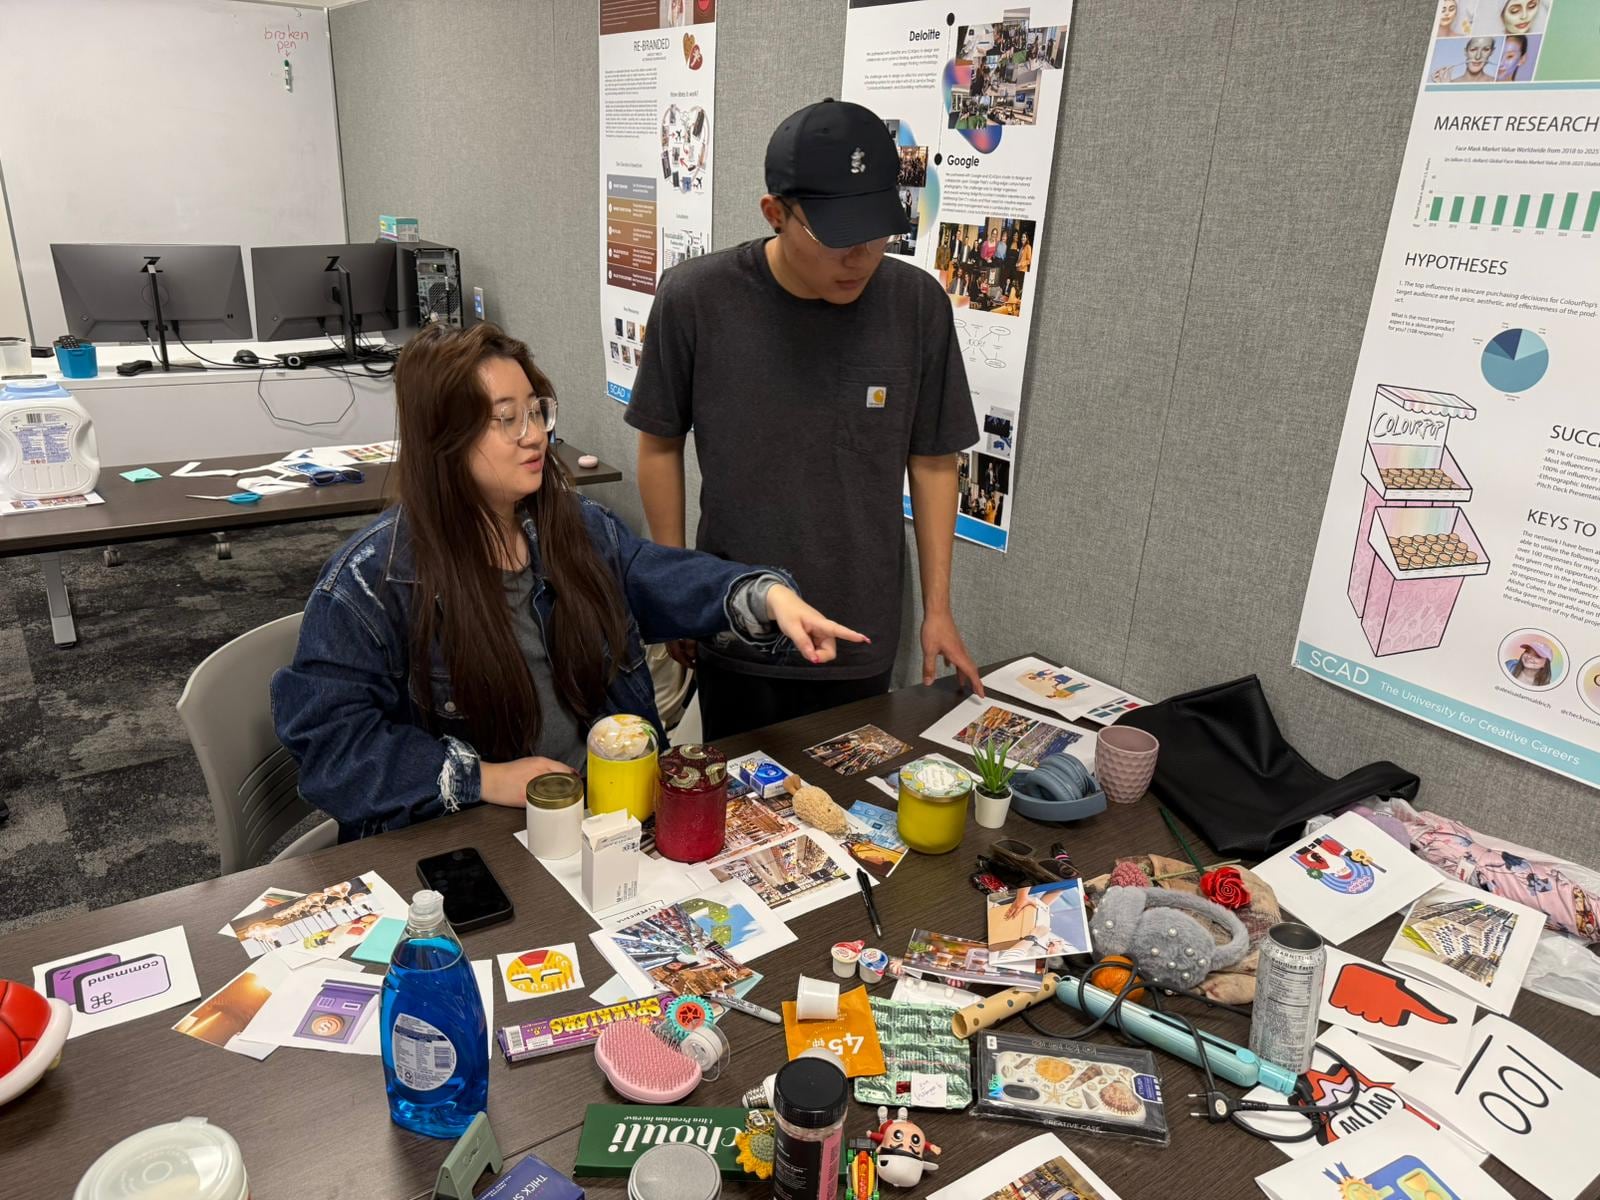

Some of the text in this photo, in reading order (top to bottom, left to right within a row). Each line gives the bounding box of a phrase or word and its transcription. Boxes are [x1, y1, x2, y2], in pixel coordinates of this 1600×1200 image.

[264, 24, 308, 40] broken
[909, 28, 940, 42] Deloitte
[277, 41, 296, 53] pen
[634, 38, 670, 52] RE-BRANDED
[1434, 116, 1600, 132] MARKET RESEARCH
[947, 154, 980, 168] Google
[1404, 252, 1508, 276] HYPOTHESES
[1425, 283, 1454, 292] influences
[1486, 290, 1519, 300] purchasing
[1520, 294, 1548, 303] decisions
[1560, 298, 1598, 308] ColourPop's
[1477, 298, 1504, 307] aesthetic,
[1518, 303, 1557, 313] effectiveness
[610, 384, 625, 398] SCAD
[1374, 412, 1445, 440] COLOURPOP
[1550, 424, 1600, 448] SUCC
[1560, 460, 1594, 472] influencers
[1553, 485, 1567, 494] Deck
[1527, 509, 1596, 537] KEYS TO
[1523, 530, 1533, 538] The
[1534, 533, 1558, 544] network
[1578, 544, 1593, 553] been
[1541, 544, 1559, 553] utilize
[1570, 551, 1599, 565] following
[1543, 554, 1572, 566] responses
[1512, 563, 1552, 578] entrepreneurs
[1572, 578, 1598, 591] industry.
[1526, 557, 1542, 566] given
[1565, 568, 1600, 583] opportunity
[1507, 578, 1525, 587] Alisha
[1526, 583, 1546, 593] Cohen,
[1558, 593, 1577, 602] owner
[1518, 573, 1547, 585] responses
[1568, 586, 1599, 600] influencer
[1505, 585, 1522, 595] Alisha
[1523, 591, 1537, 599] gave
[1549, 599, 1564, 608] great
[1565, 603, 1584, 613] advice
[1513, 597, 1552, 612] development
[1309, 650, 1370, 686] SCAD
[1380, 681, 1580, 766] The University for Creative Careers
[60, 970, 72, 981] Z
[88, 960, 159, 987] command
[550, 998, 662, 1036] SPARKLERS
[828, 1032, 864, 1055] 45
[1043, 1118, 1100, 1133] CREATIVE CASE
[521, 1174, 548, 1196] THICK
